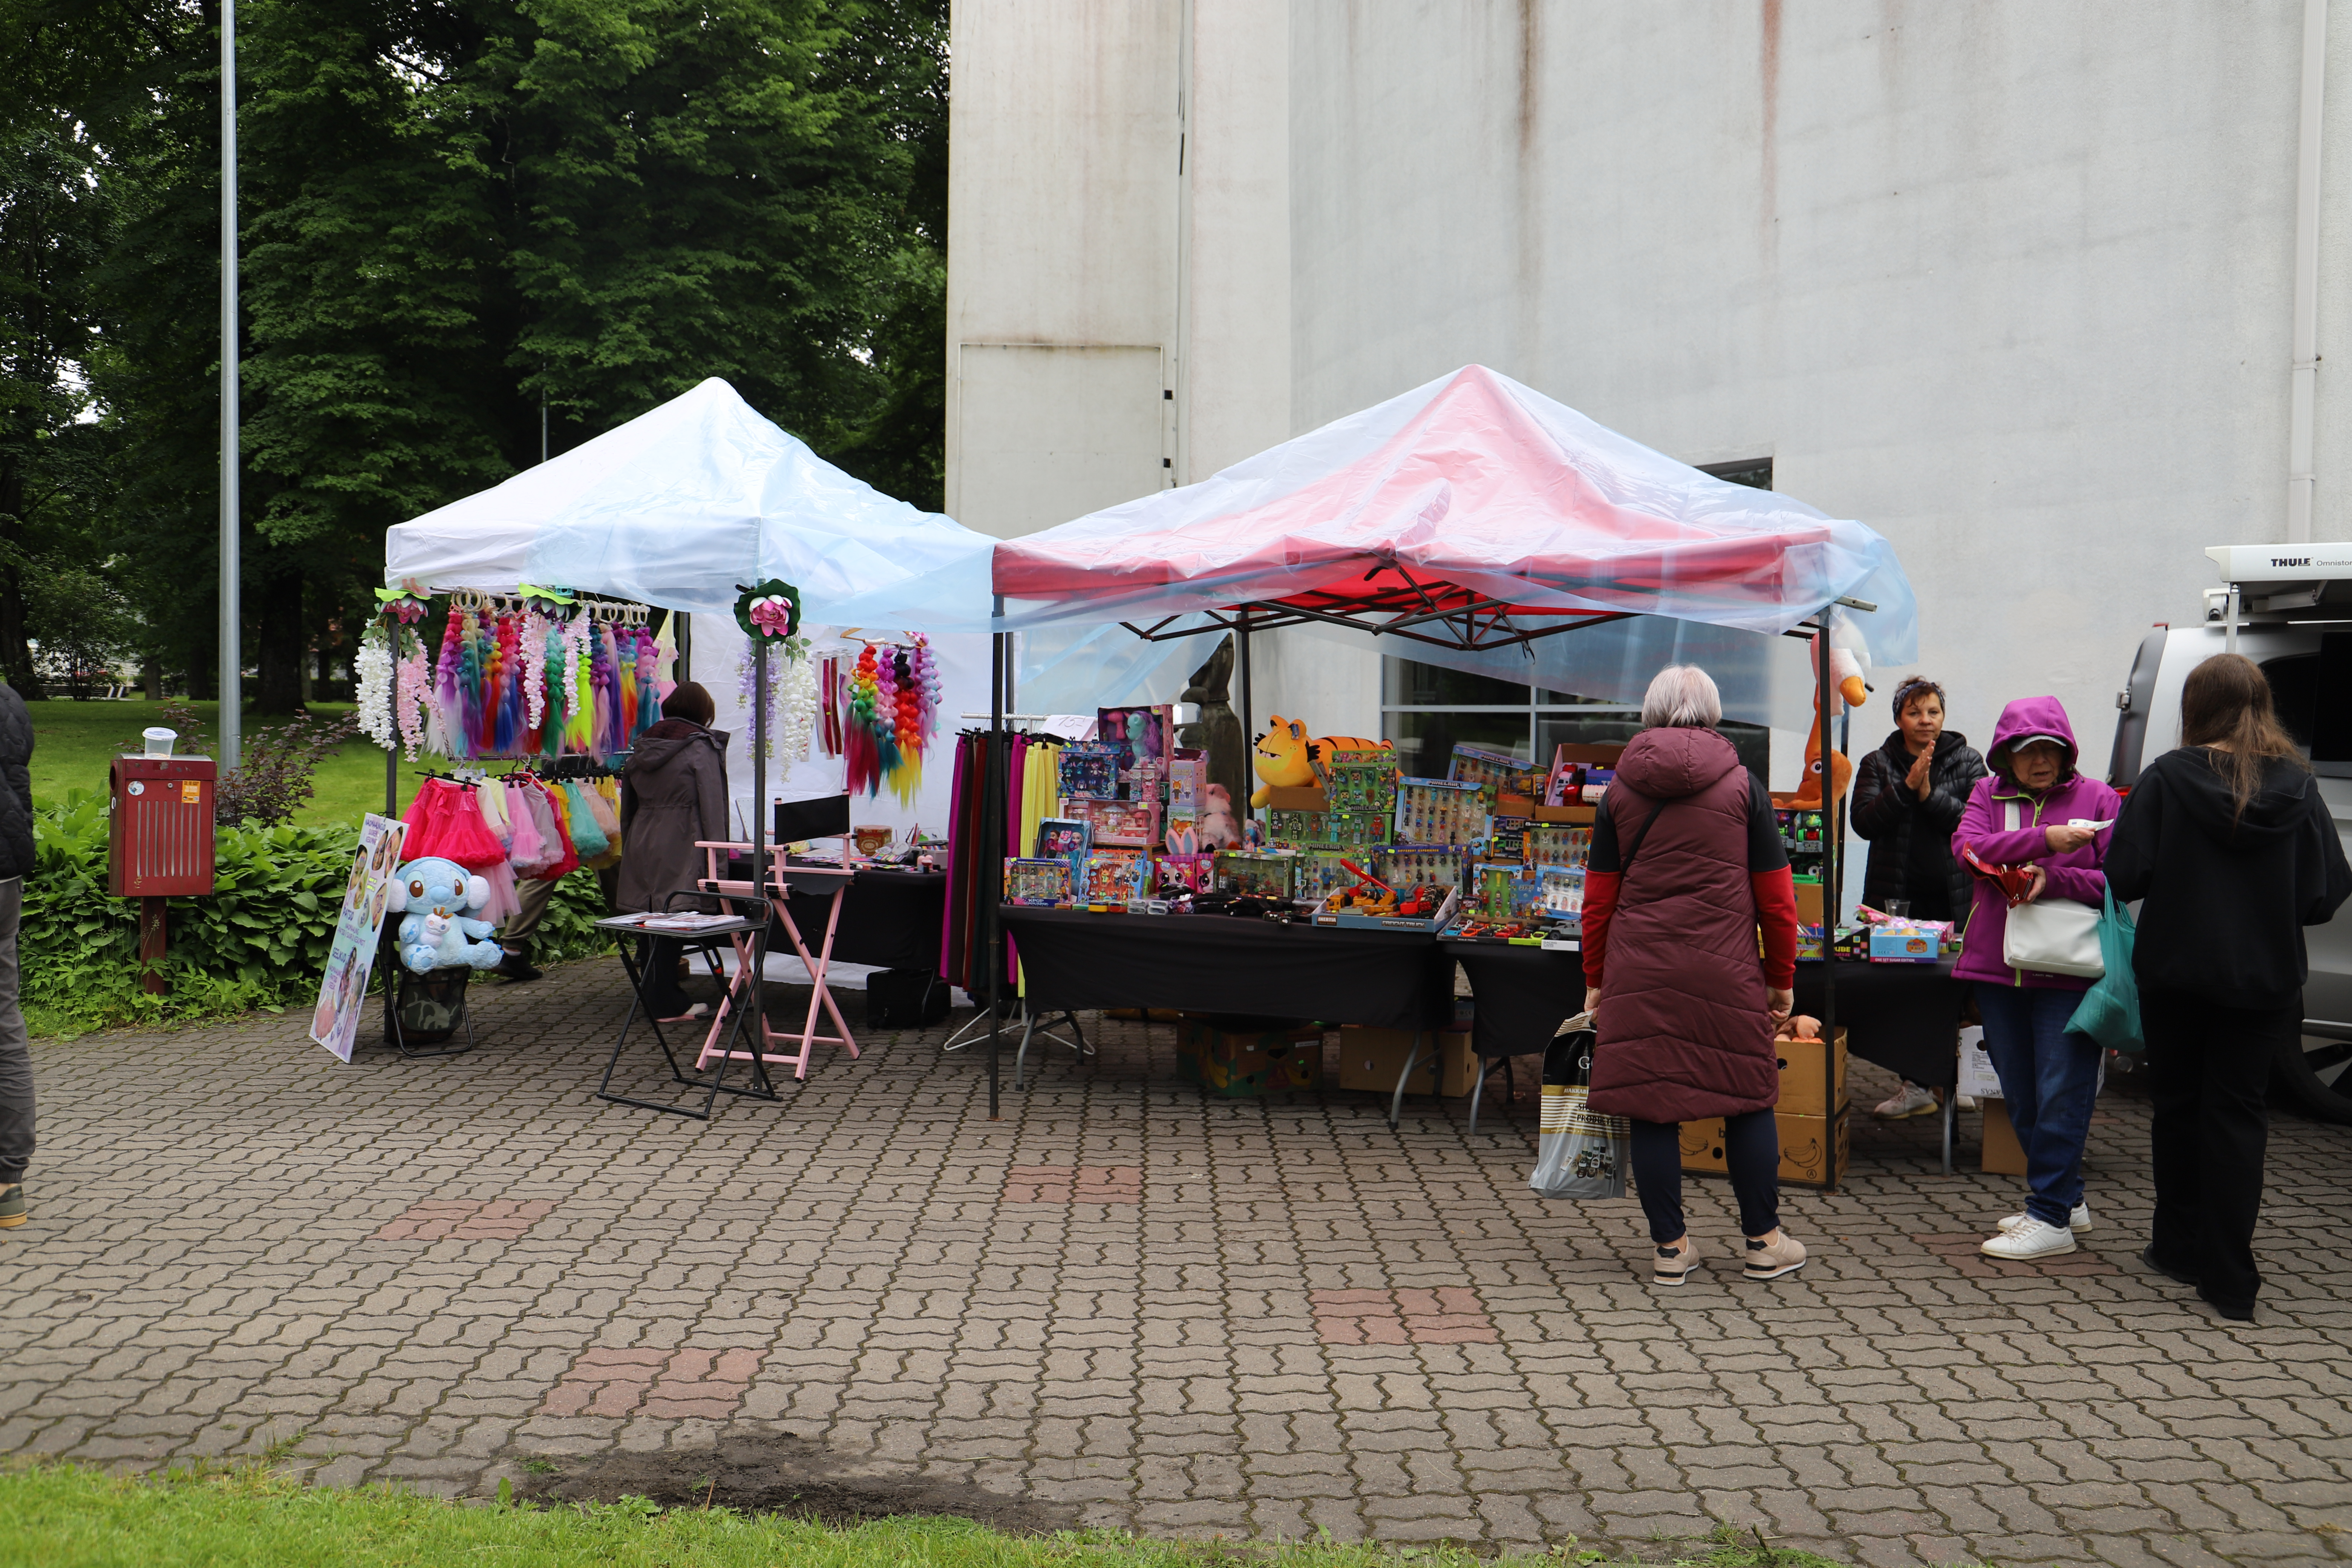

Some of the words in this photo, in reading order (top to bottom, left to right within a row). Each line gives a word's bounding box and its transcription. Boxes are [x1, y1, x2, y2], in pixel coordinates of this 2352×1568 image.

[2271, 558, 2311, 567] THULE
[1481, 754, 1514, 766] MINECRAFT
[341, 907, 354, 921] PATSID
[332, 947, 347, 963] SEELIKUD
[1577, 1115, 1614, 1125] PRODUCTS
